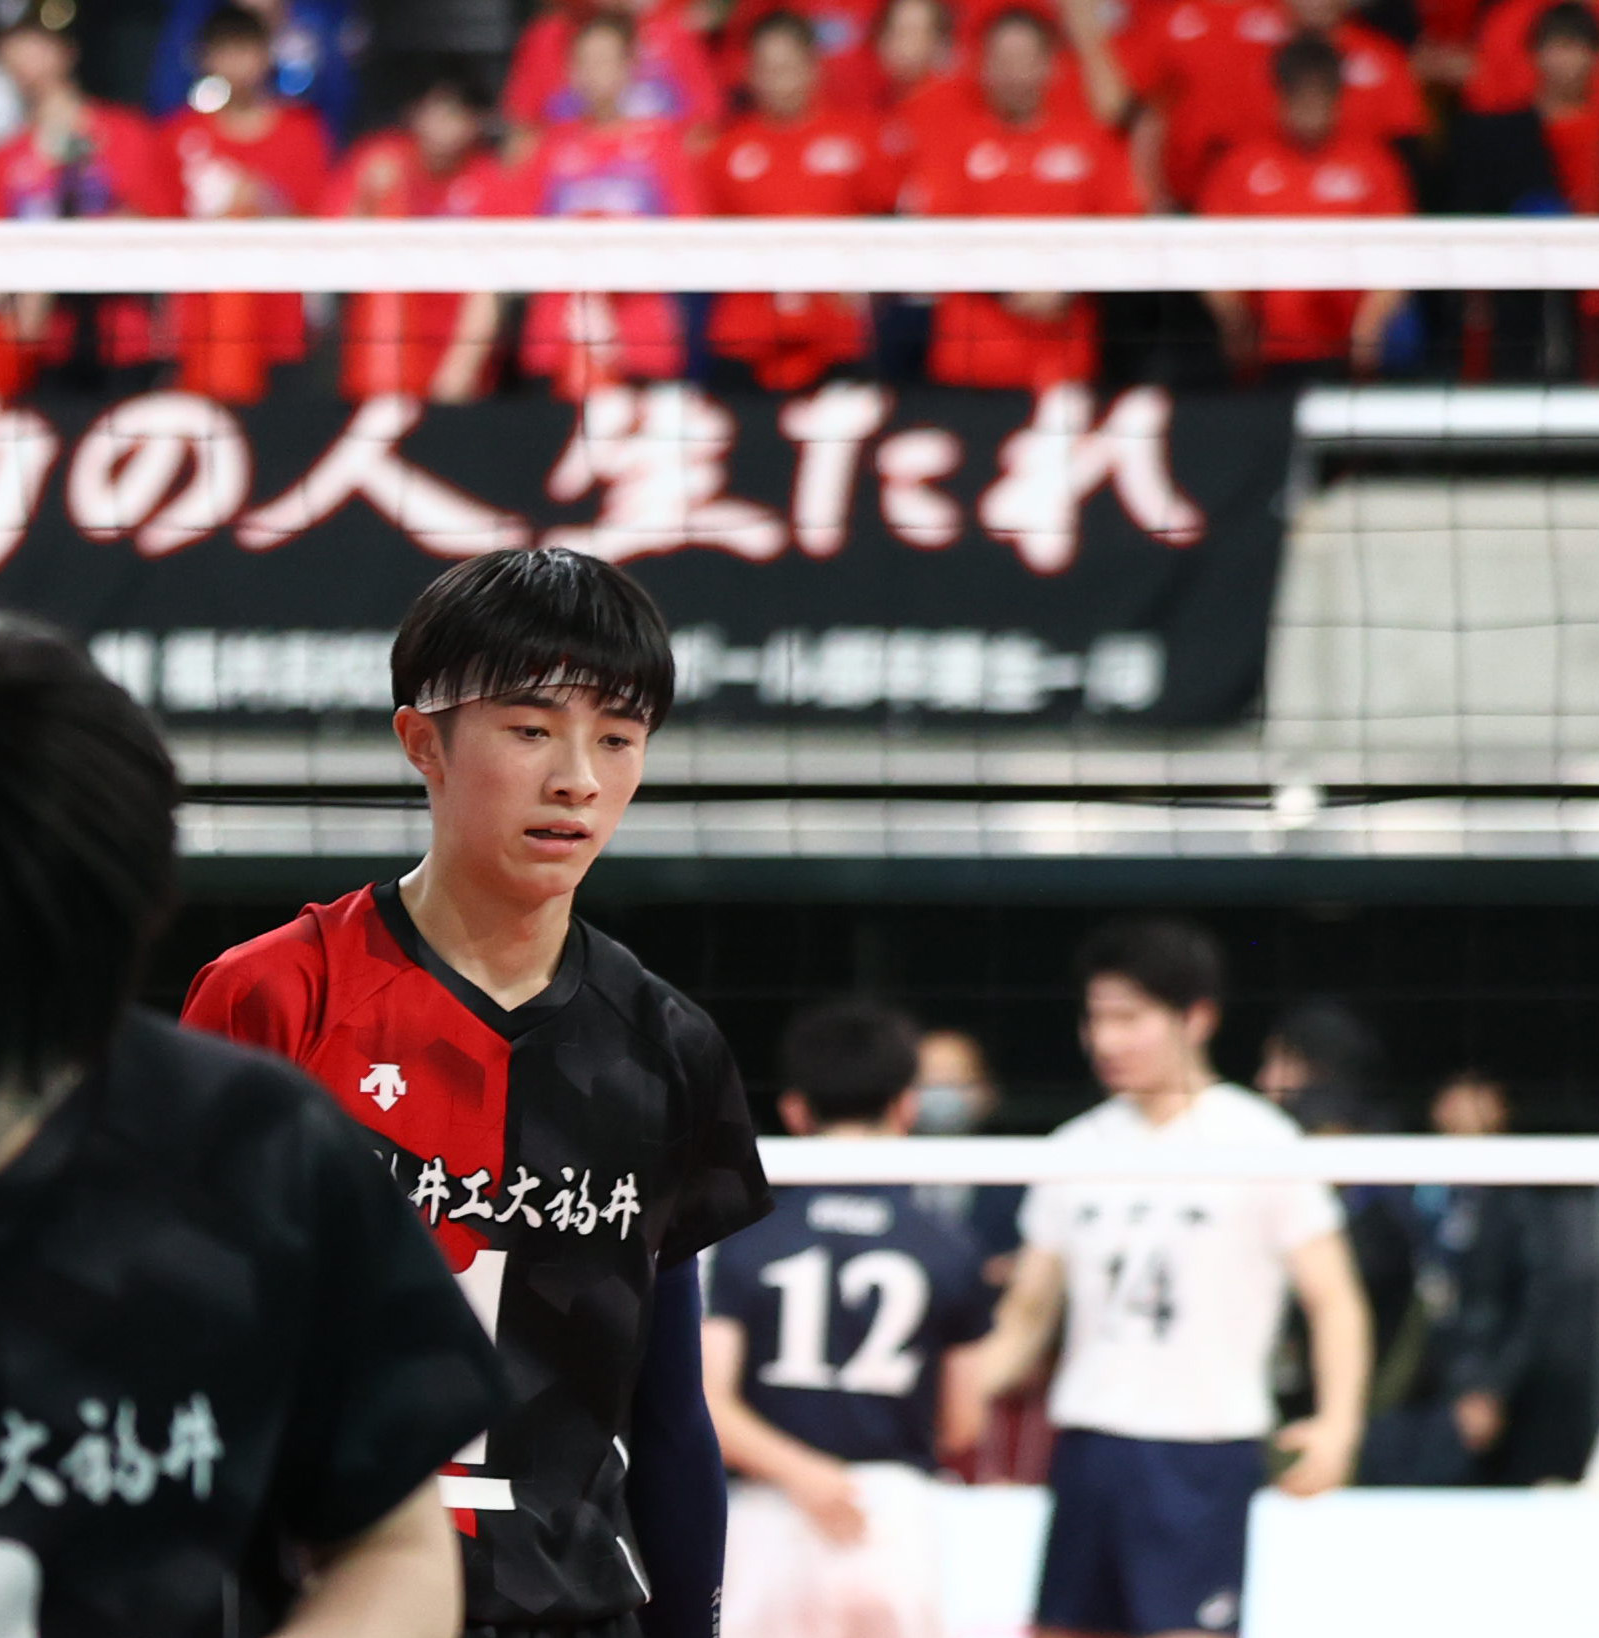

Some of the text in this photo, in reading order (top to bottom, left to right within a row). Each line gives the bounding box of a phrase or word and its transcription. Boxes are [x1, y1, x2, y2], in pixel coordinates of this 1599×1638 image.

[373, 1149, 642, 1240] 井工大福井
[758, 1245, 931, 1397] 12
